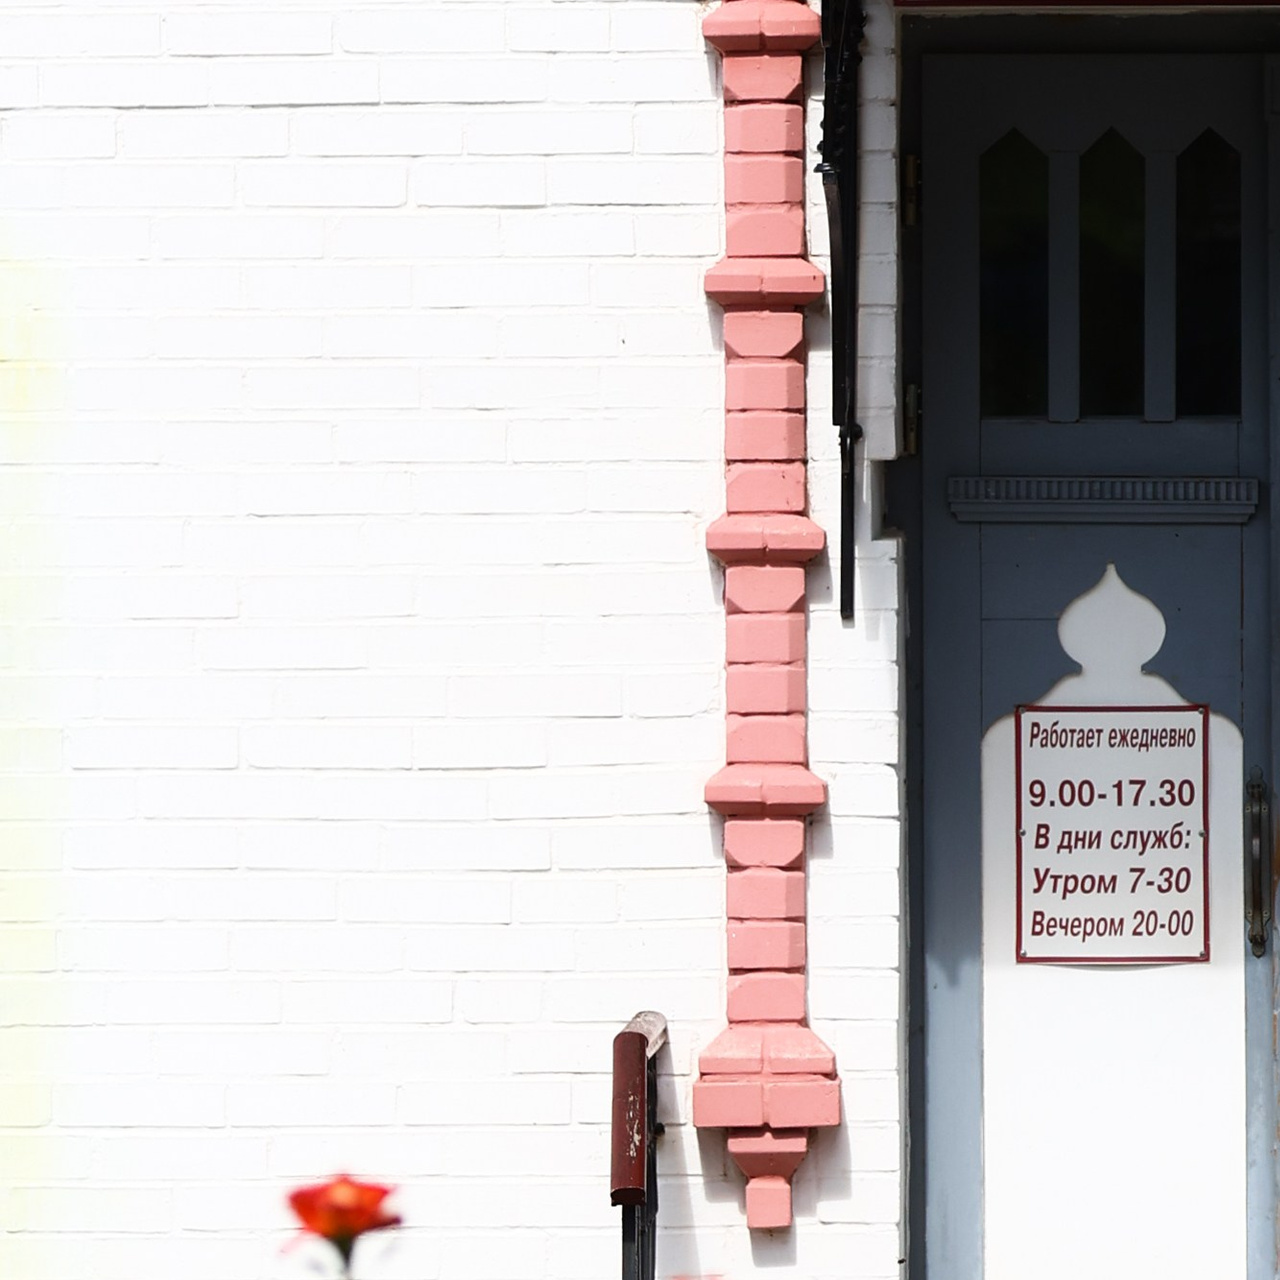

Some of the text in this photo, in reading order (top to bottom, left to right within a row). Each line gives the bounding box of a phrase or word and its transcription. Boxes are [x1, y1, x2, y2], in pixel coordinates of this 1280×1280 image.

[1030, 721, 1196, 752] Работает ежедневно
[1029, 779, 1195, 807] 9.00-17.30
[1034, 821, 1191, 856] В дни служб:
[1033, 867, 1191, 900] Утром 7-30
[1031, 909, 1194, 942] Вечером 20-00
